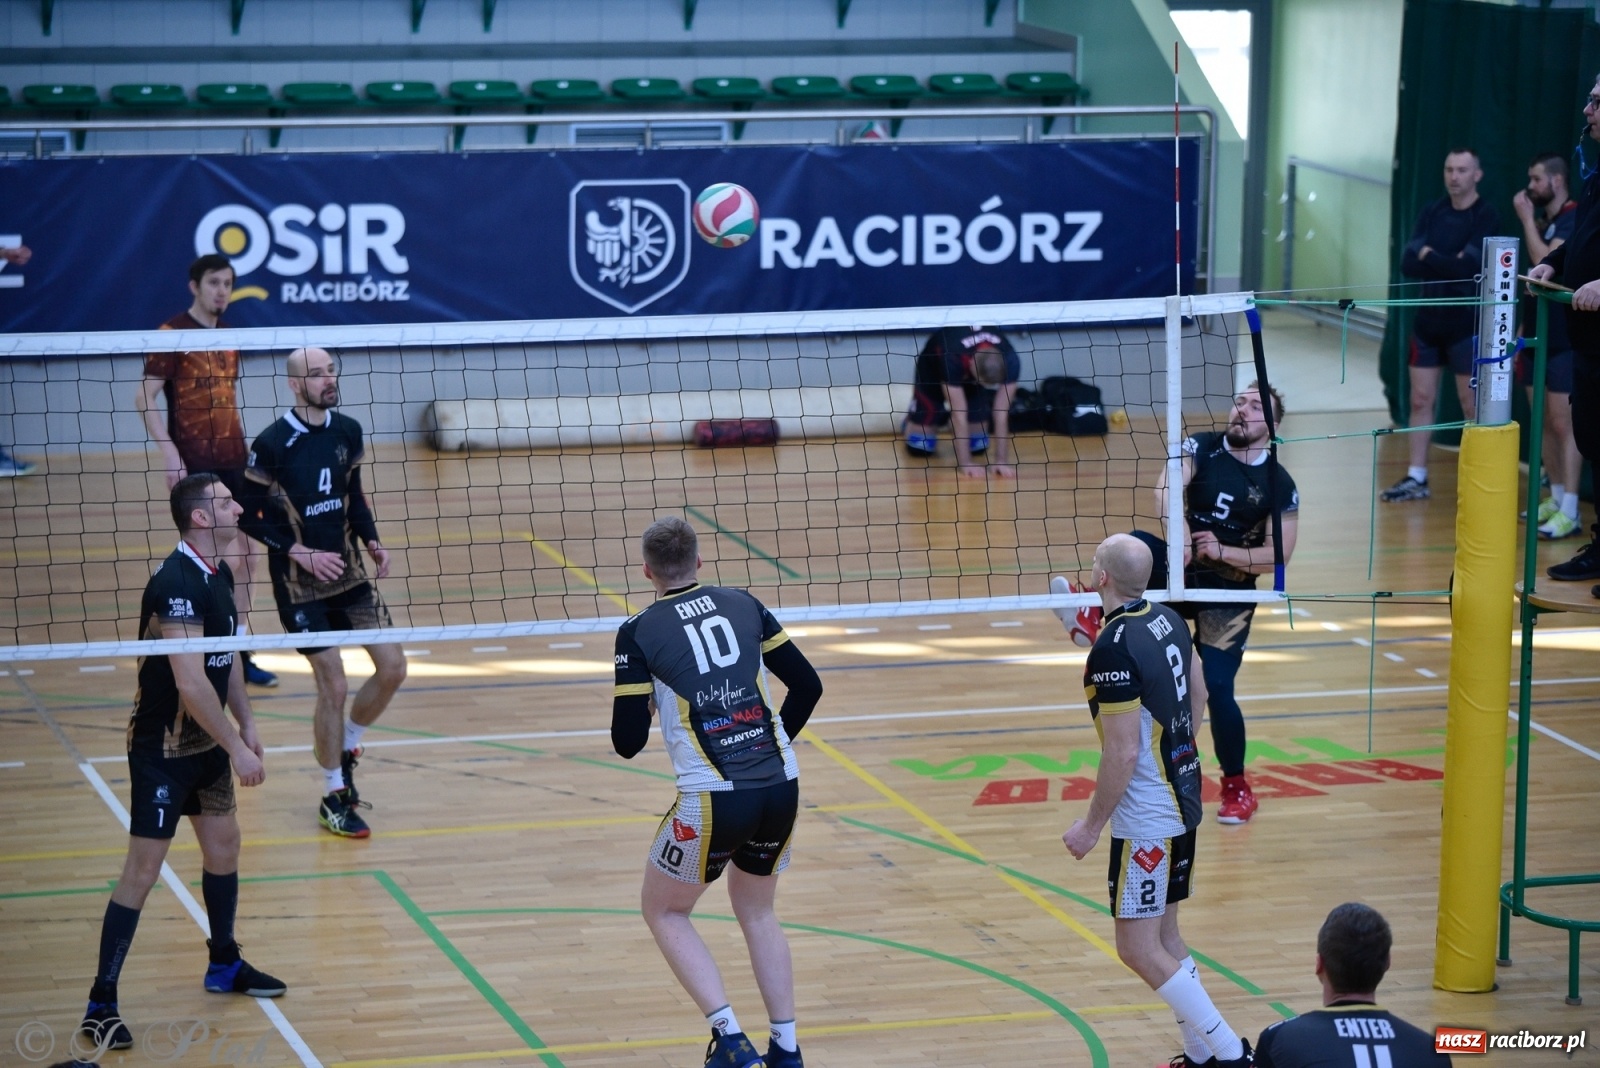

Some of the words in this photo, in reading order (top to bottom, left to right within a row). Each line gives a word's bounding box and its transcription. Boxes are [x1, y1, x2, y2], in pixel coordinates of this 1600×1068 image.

[760, 195, 1104, 270] RACIBÓRZ
[281, 278, 410, 304] RACIBÓRZ
[319, 467, 333, 495] 4
[1212, 492, 1235, 520] 5
[674, 595, 717, 620] ENTER
[683, 615, 741, 675] 10
[1165, 643, 1188, 702] 2
[718, 679, 746, 710] Hair
[720, 727, 764, 747] GRAVTON
[157, 807, 165, 828] 1
[661, 839, 685, 867] 10
[1138, 850, 1155, 867] Enter
[1140, 880, 1156, 906] 2
[1334, 1018, 1396, 1040] ENTER
